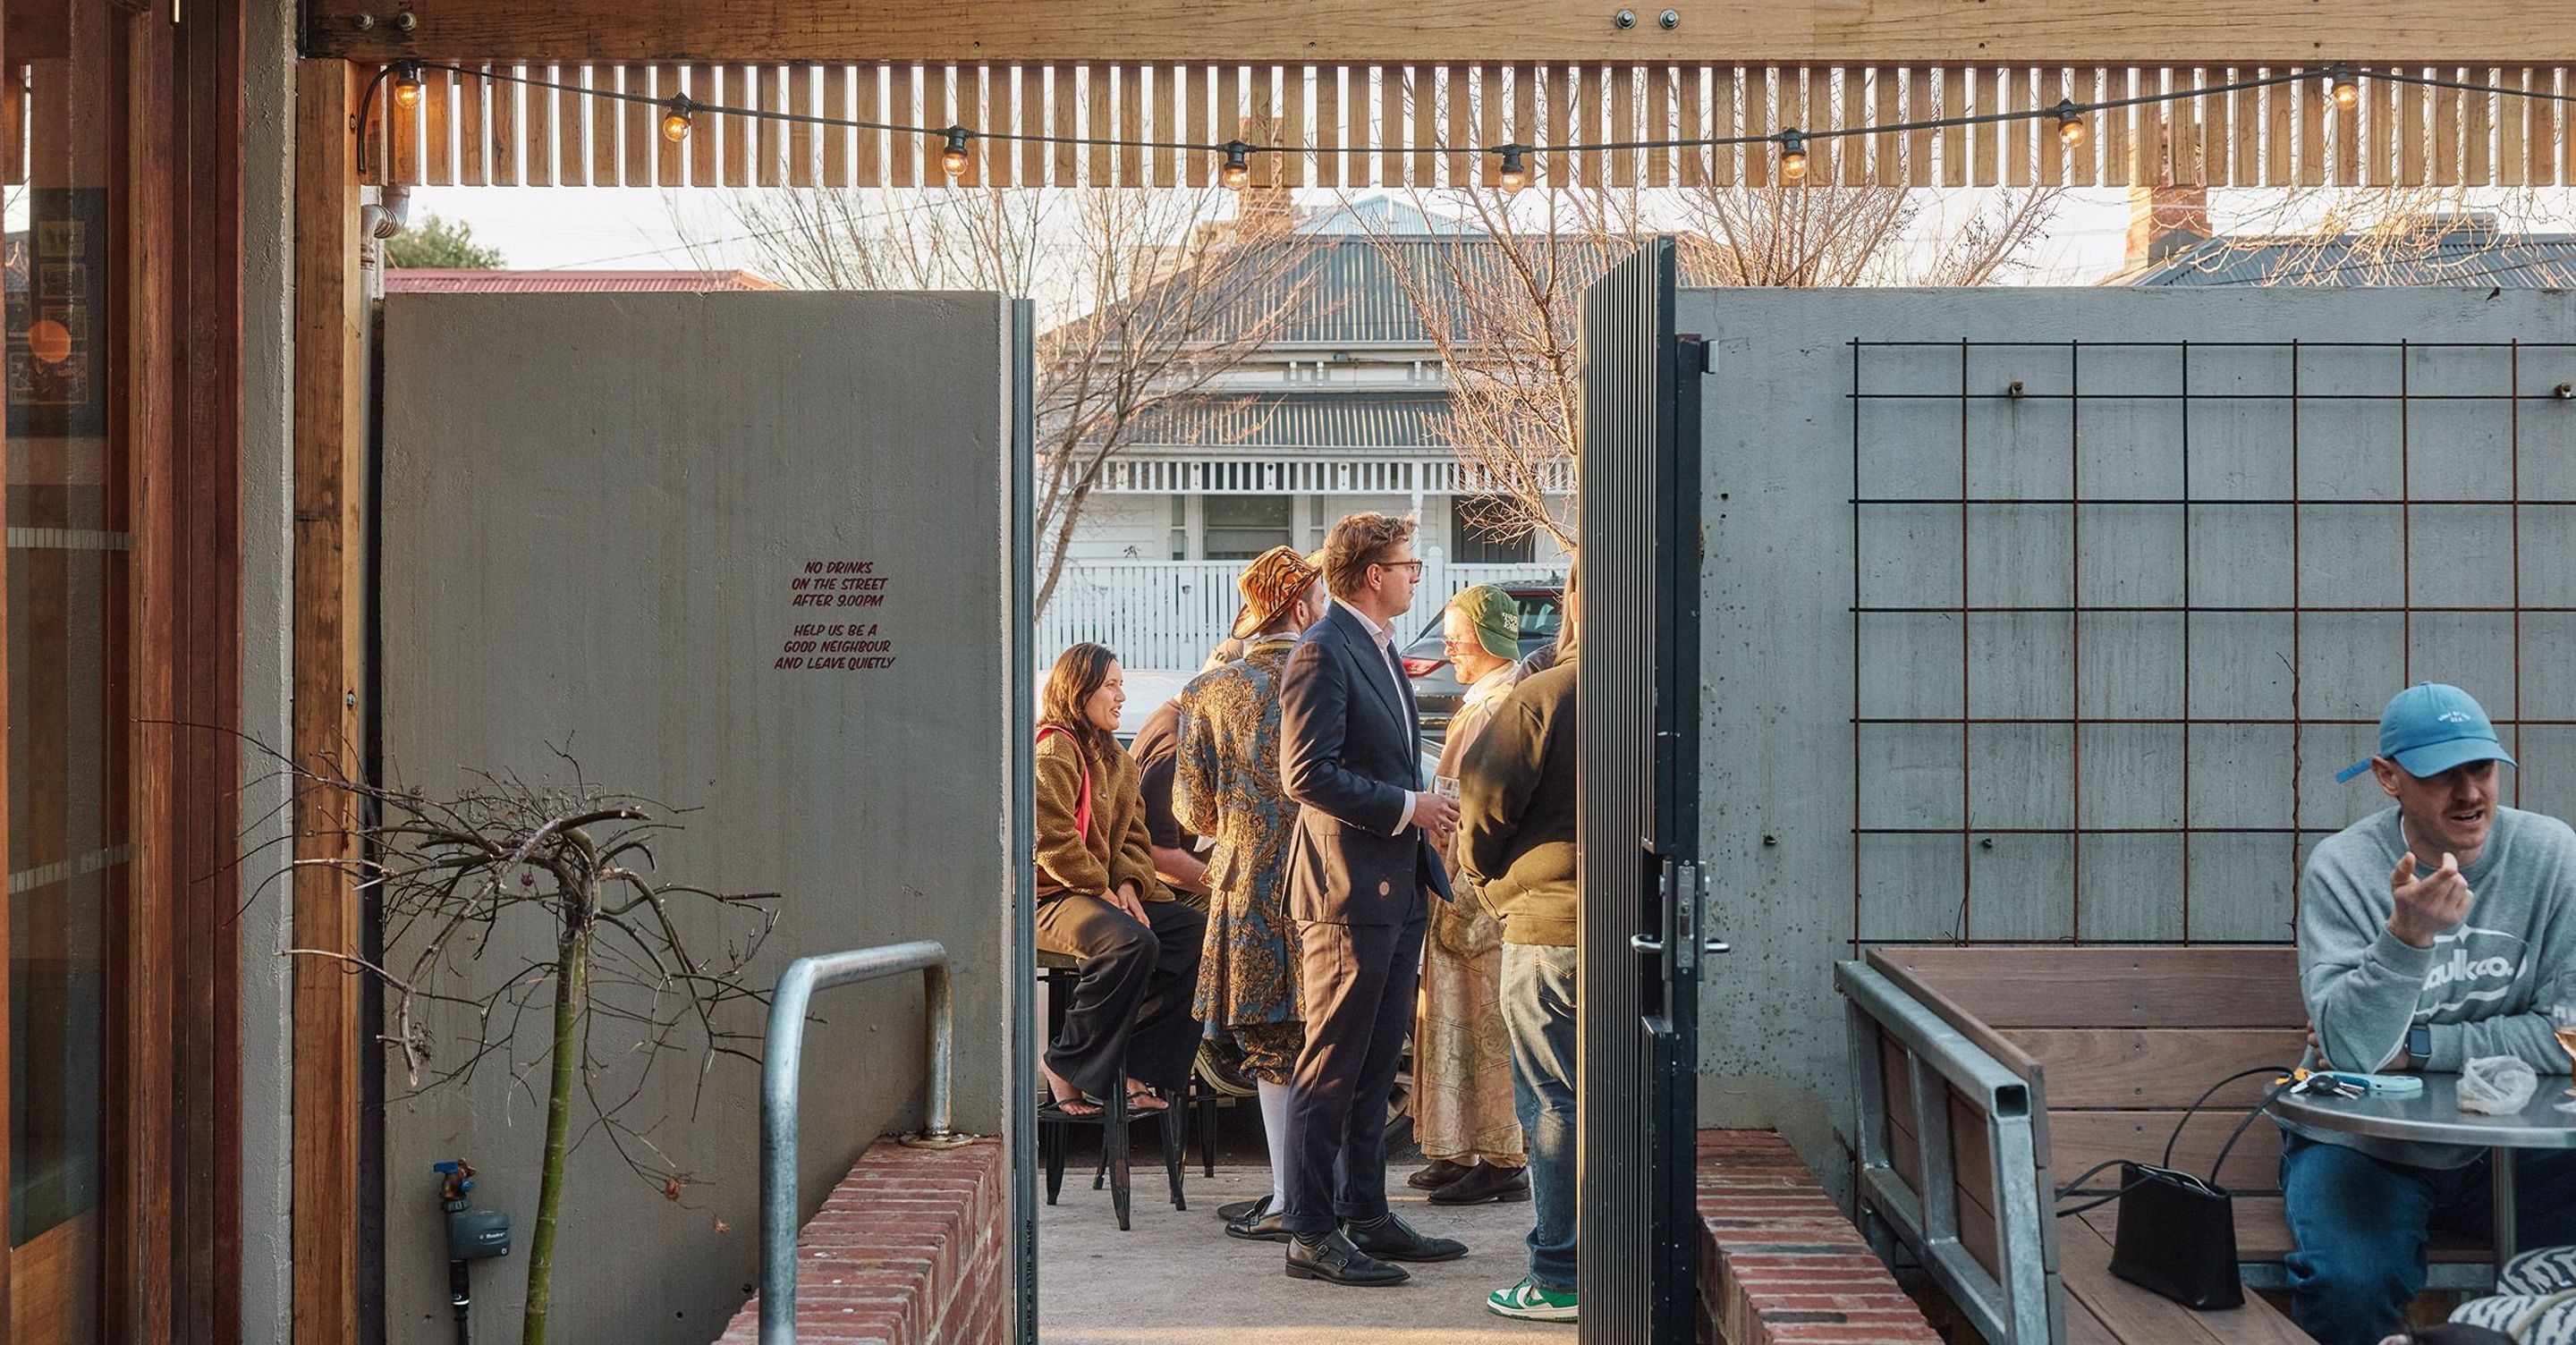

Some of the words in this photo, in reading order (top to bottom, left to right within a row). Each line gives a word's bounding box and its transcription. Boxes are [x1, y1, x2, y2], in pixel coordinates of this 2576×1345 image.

[804, 562, 823, 574] NO
[826, 562, 874, 574] DRINKS
[792, 578, 810, 590] ON
[813, 578, 837, 590] THE
[841, 578, 888, 590] STREET
[792, 594, 834, 606] AFTER
[836, 594, 885, 606] 9.00PM
[793, 624, 826, 636] HELP
[828, 624, 844, 636] US
[848, 624, 865, 636] BE
[868, 623, 878, 636] A
[784, 640, 817, 653] GOOD
[820, 639, 892, 653] NEIGHBOUR
[774, 656, 803, 670] AND
[807, 656, 846, 669] LEAVE
[849, 656, 896, 671] QUIETLY
